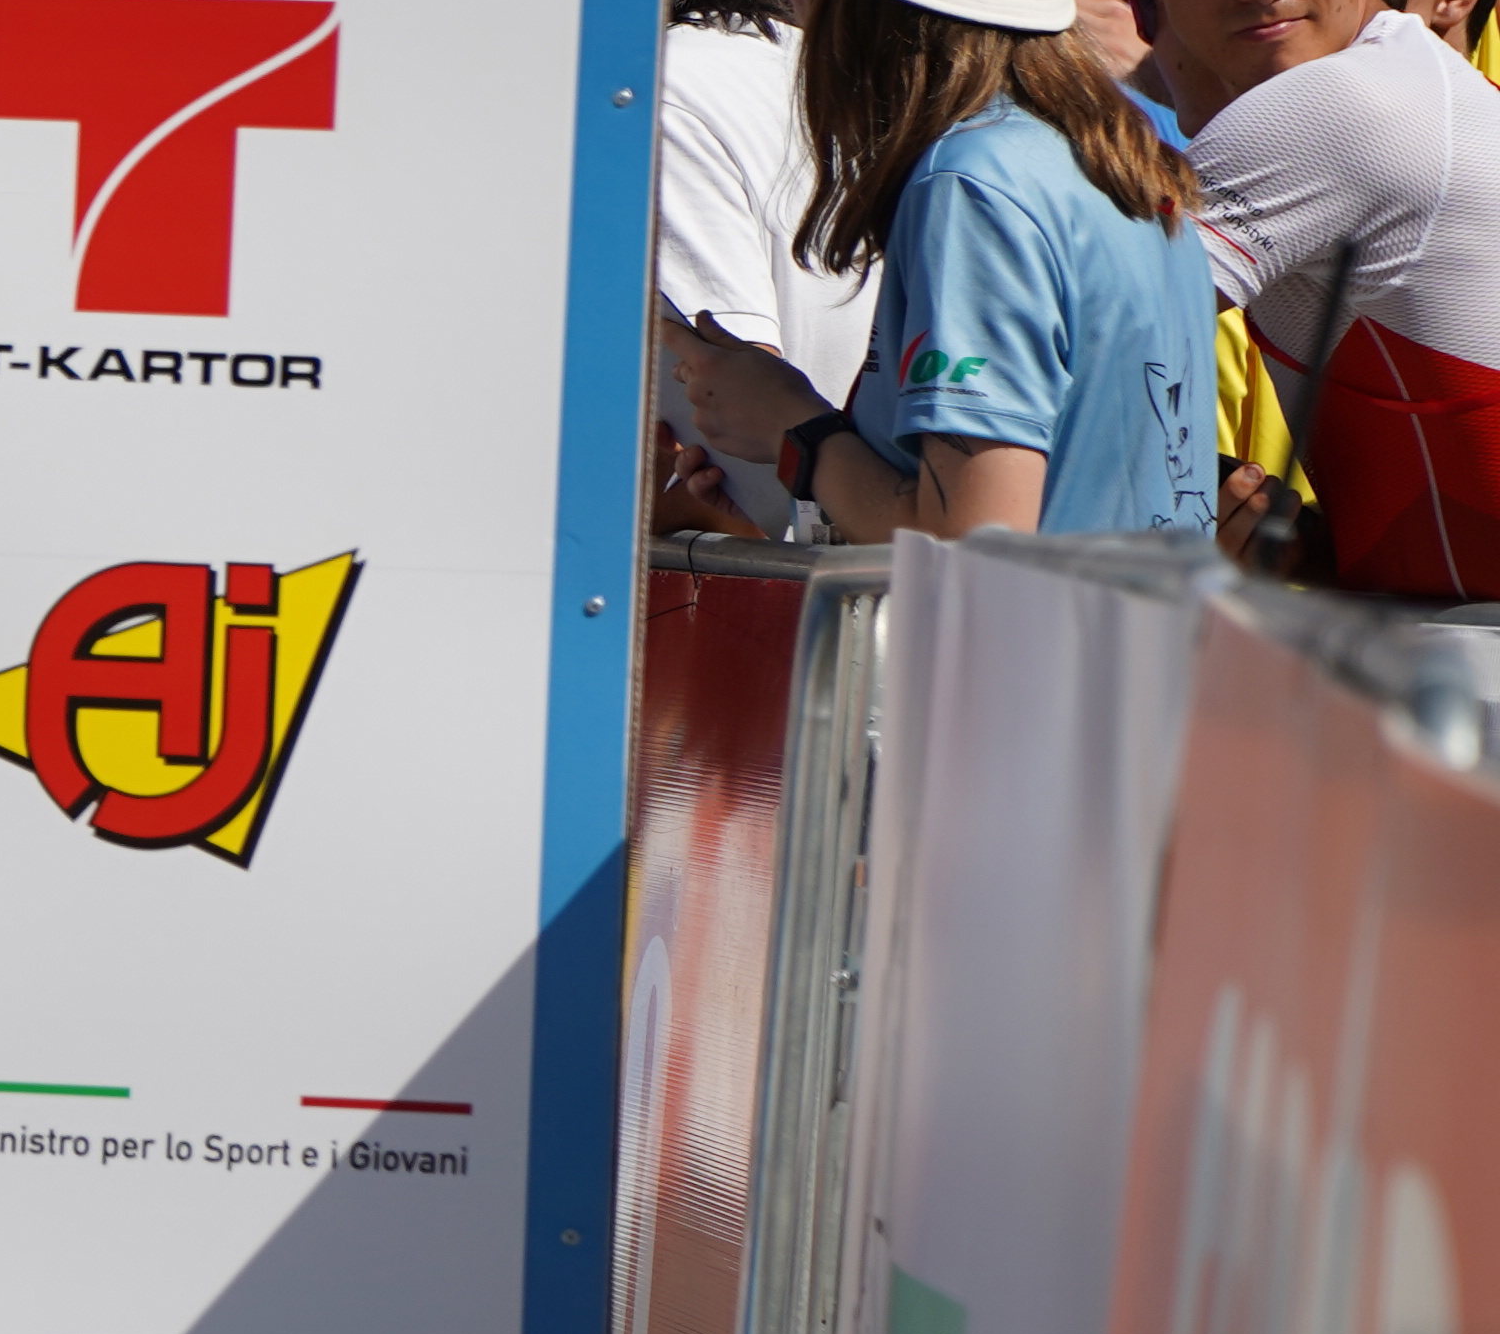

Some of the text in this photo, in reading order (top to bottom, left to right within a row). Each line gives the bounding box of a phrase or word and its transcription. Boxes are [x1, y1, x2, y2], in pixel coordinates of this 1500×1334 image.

[101, 1133, 155, 1165] per
[165, 1132, 194, 1162] lo
[203, 1134, 291, 1170] Sport
[301, 1148, 319, 1168] e
[330, 1140, 339, 1170] i
[348, 1141, 471, 1177] Giovani
